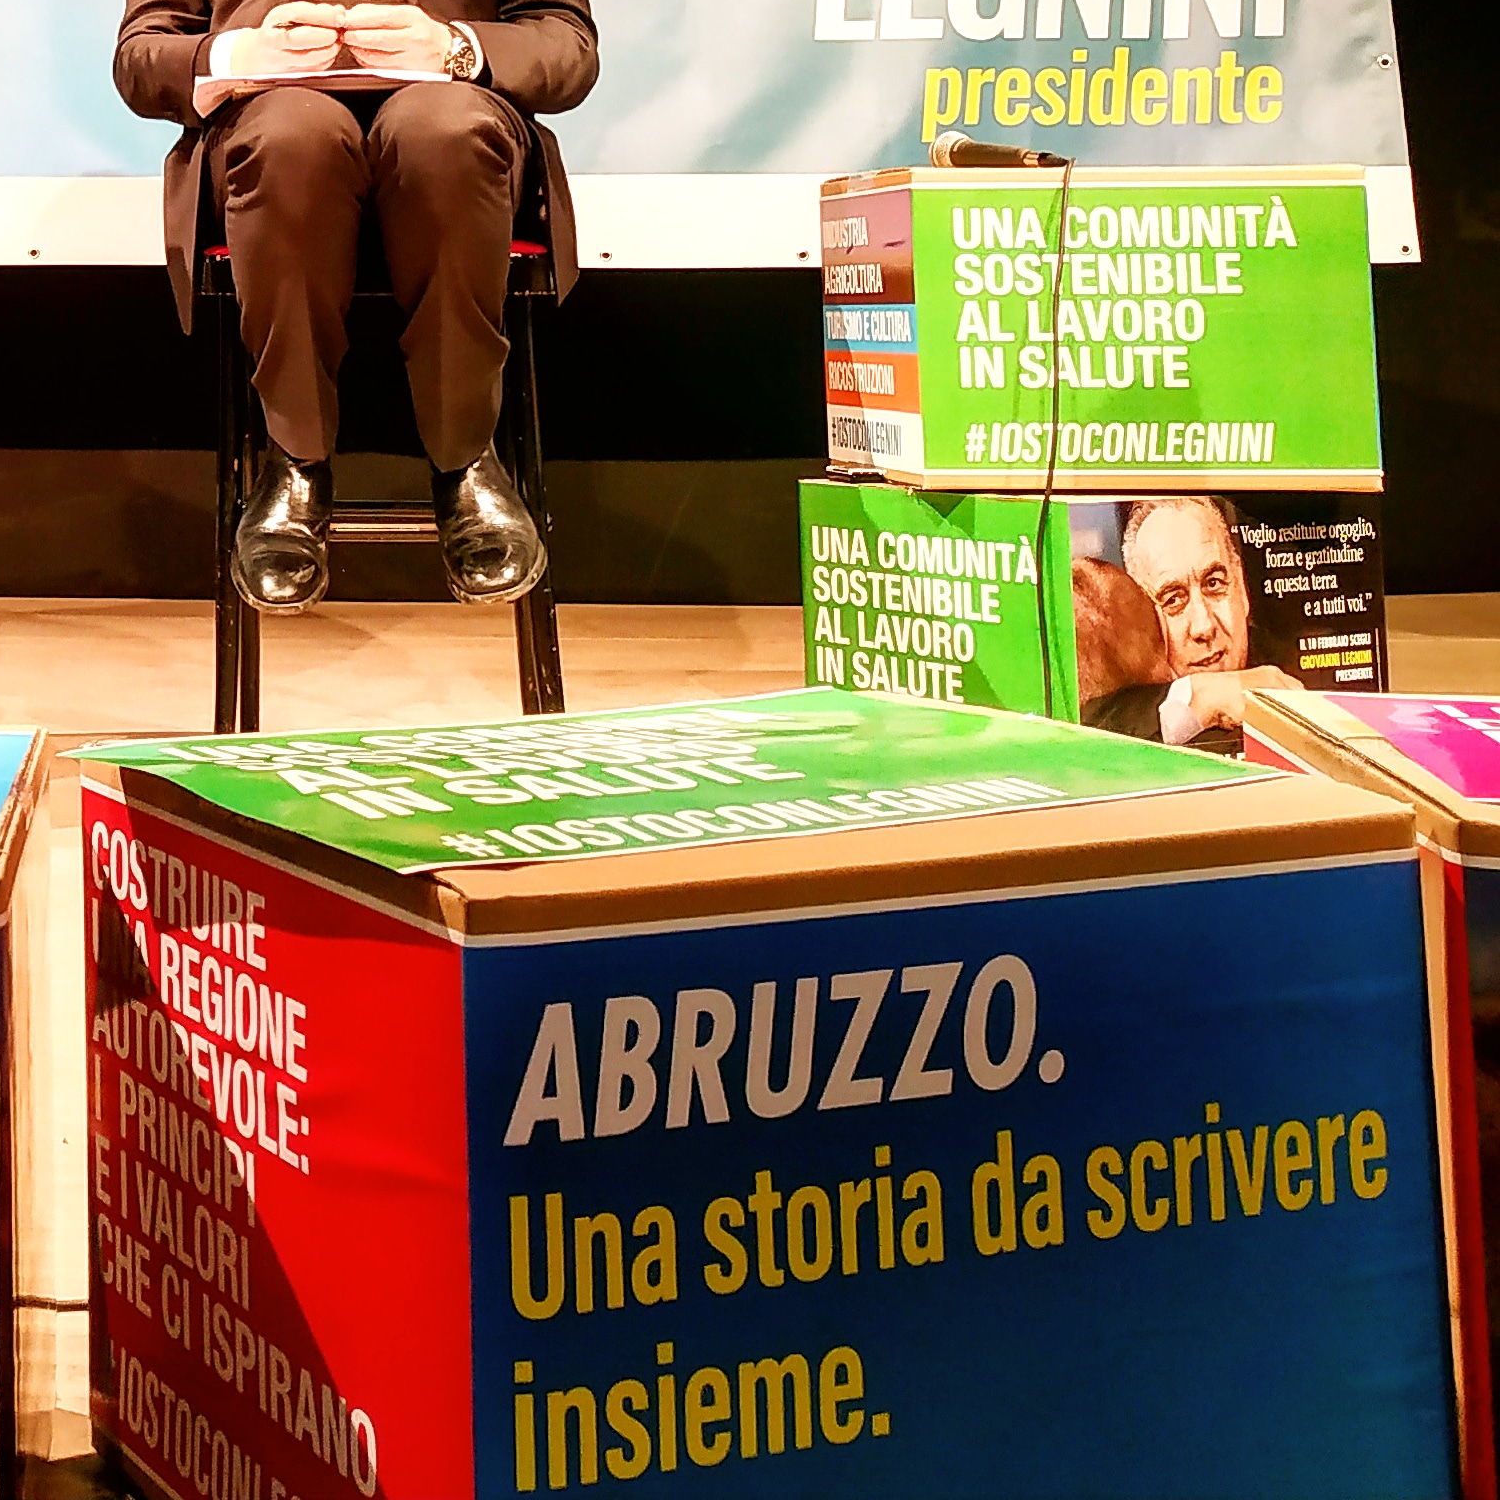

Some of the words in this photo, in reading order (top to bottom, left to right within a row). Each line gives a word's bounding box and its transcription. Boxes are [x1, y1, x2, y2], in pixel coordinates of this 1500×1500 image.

[920, 47, 1283, 142] presidente
[952, 206, 1047, 249] UNA
[1063, 196, 1298, 249] COMUNITÀ
[824, 263, 884, 295] AGRICOLTURA
[954, 252, 1244, 296] SOSTENIBILE
[870, 311, 912, 343] CULTURA
[956, 299, 1015, 342] AL
[1027, 298, 1206, 342] LAVORO
[828, 361, 895, 396] RICOSTRUZIONI
[959, 345, 1005, 388] IN
[1018, 345, 1190, 389] SALUTE
[965, 422, 1276, 464] #IOSTOCONLEGNINI
[811, 525, 870, 566] UNA
[877, 531, 1038, 585] COMUNITÀ
[1266, 547, 1294, 568] forza
[1296, 552, 1303, 566] e
[1305, 543, 1364, 570] gratitudine
[1279, 521, 1327, 542] restituire
[1328, 516, 1376, 543] orgoglio,
[812, 565, 1001, 624] SOSTENIBILE
[1264, 580, 1272, 594] a
[1274, 575, 1310, 598] questa
[1311, 573, 1338, 591] terra
[1304, 601, 1311, 616] e
[1313, 600, 1321, 615] a
[1323, 594, 1346, 615] tutti
[814, 606, 850, 645] AL
[857, 610, 975, 662] LAVORO
[816, 646, 845, 685] IN
[852, 651, 965, 703] SALUTE
[277, 765, 415, 795] AL
[398, 739, 758, 780] LAVORO
[320, 786, 453, 820] IN
[443, 755, 807, 805] SALUTE
[439, 777, 1071, 859] #IOSTOCONLEGNINI
[91, 821, 268, 972] COSTRUIRE
[160, 932, 309, 1083] REGIONE
[503, 954, 1066, 1147] ABRUZZO.
[92, 998, 310, 1175] AUTOREVOLE:
[119, 1070, 256, 1228] PRINCIPI
[95, 1133, 112, 1207] E
[120, 1150, 128, 1220] I
[135, 1161, 250, 1311] VALORI
[509, 1192, 678, 1320] Una
[703, 1145, 946, 1295] storia
[972, 1130, 1064, 1256] da
[1086, 1101, 1389, 1239] scrivere
[97, 1212, 153, 1319] CHE
[161, 1263, 192, 1351] CI
[203, 1293, 378, 1498] ISPIRANO
[513, 1341, 891, 1493] insieme.
